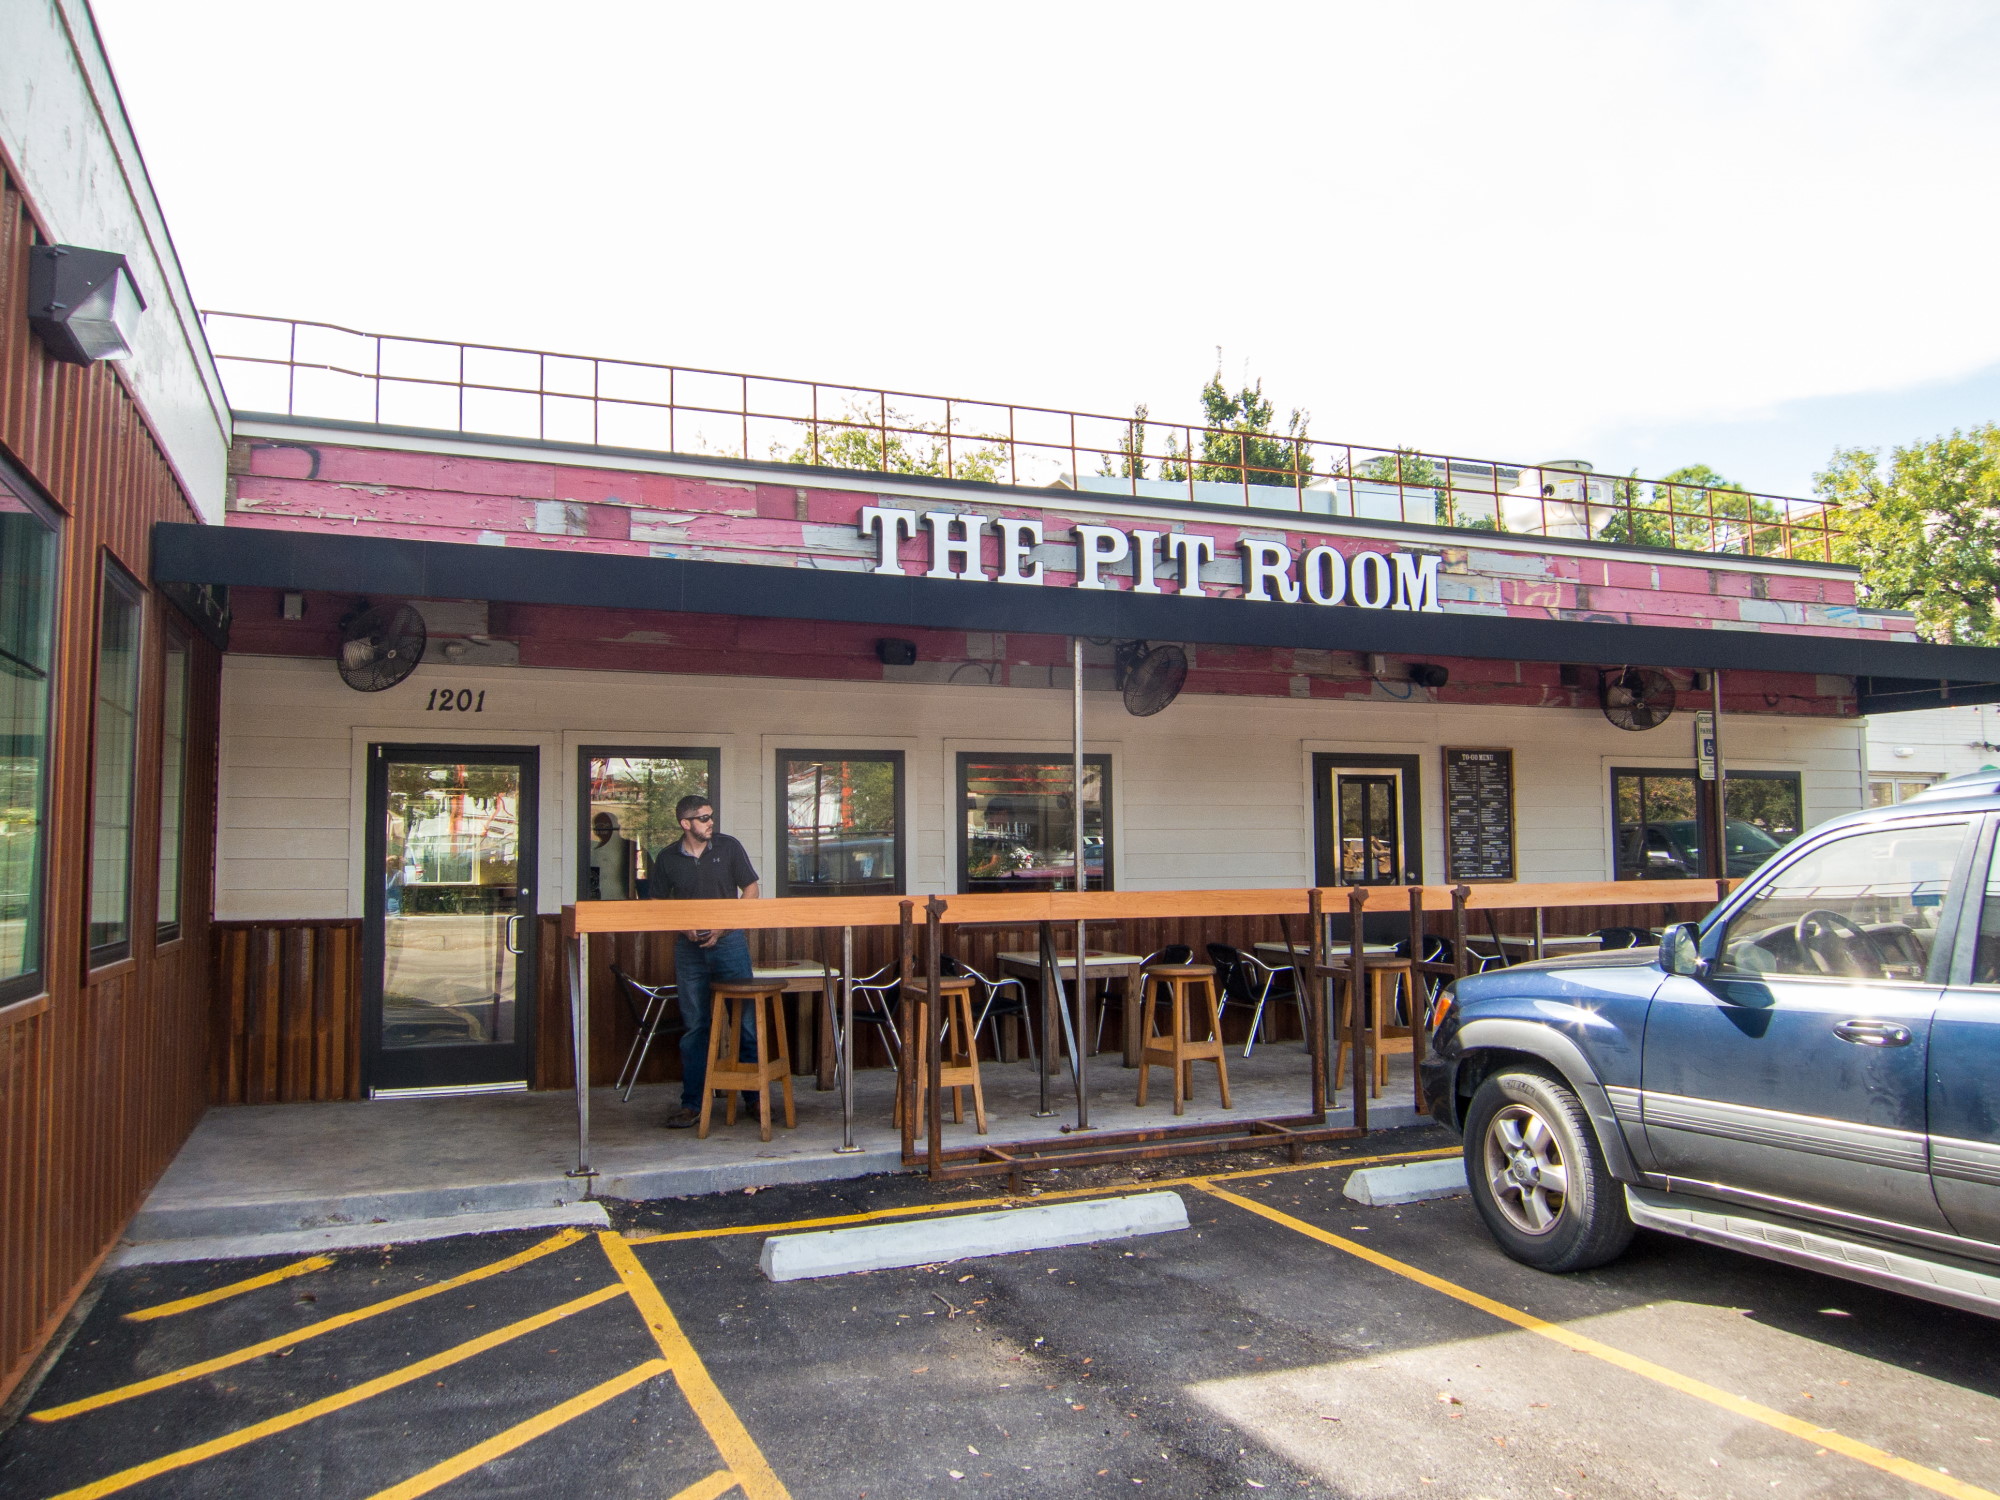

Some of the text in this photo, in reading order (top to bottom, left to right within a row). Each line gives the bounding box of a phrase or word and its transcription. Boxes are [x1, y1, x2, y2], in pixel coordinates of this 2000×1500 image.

[858, 506, 1444, 613] THE PIT ROOM
[426, 688, 486, 713] 1201
